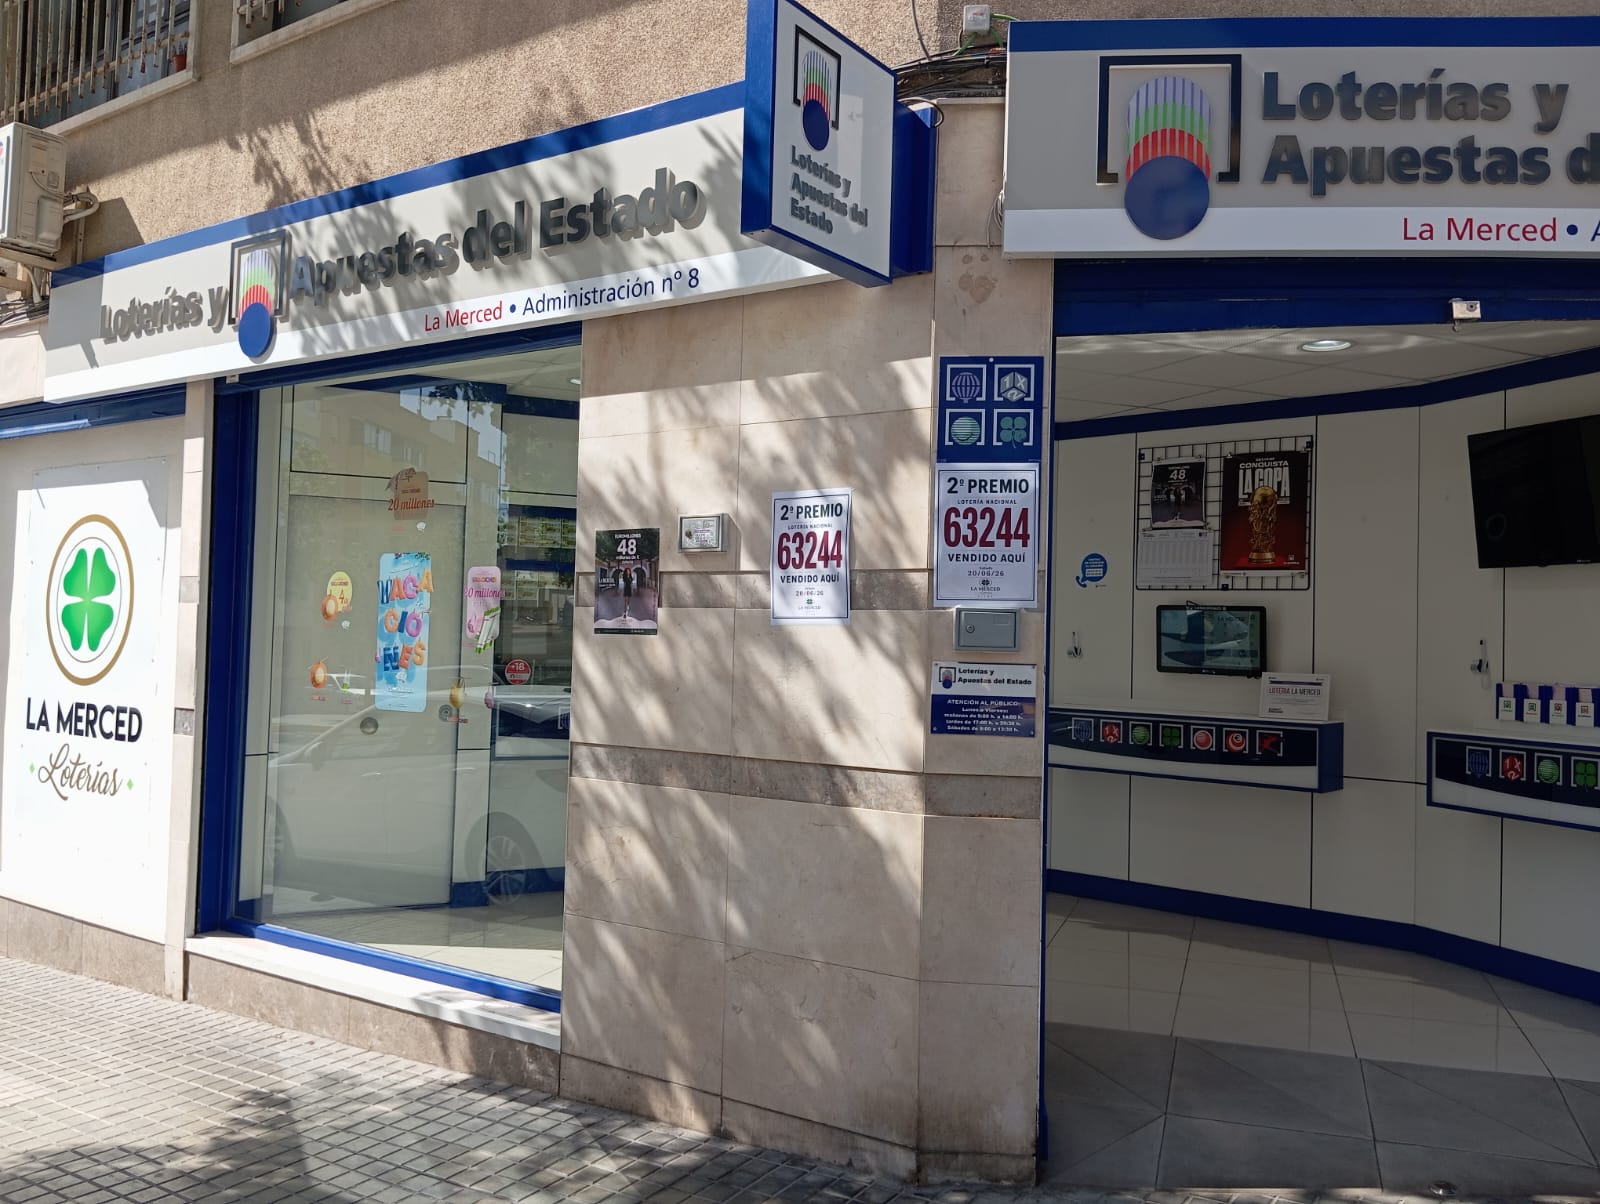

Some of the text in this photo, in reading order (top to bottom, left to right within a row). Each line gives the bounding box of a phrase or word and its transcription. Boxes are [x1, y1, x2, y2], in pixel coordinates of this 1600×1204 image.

[1262, 67, 1569, 135] Loterías y
[790, 144, 852, 198] Loterías y
[1261, 134, 1551, 198] Apuestas
[790, 196, 834, 235] Estado
[791, 172, 868, 228] Apuestas del
[1403, 217, 1558, 242] La Merced
[102, 167, 706, 343] Loterías y Apuestas del Estado
[424, 313, 442, 332] La
[445, 302, 504, 329] Merced
[522, 276, 655, 317] Administración
[687, 267, 701, 290] 8
[1169, 469, 1187, 480] 48
[1239, 460, 1289, 469] CONQUISTA
[967, 478, 1029, 494] PREMIO
[1238, 466, 1290, 499] LA COPA
[400, 497, 435, 511] millones
[796, 502, 843, 520] PREMIO
[943, 506, 1031, 548] 63244
[616, 539, 637, 556] 48
[777, 529, 843, 570] 63244
[948, 552, 1026, 563] VENDIDO AQUÍ
[780, 571, 840, 584] VENDIDO AQUÍ
[509, 662, 525, 671] +18
[958, 667, 988, 675] Loterías
[26, 697, 143, 742] LA MERCED
[38, 743, 123, 801] Loterías
